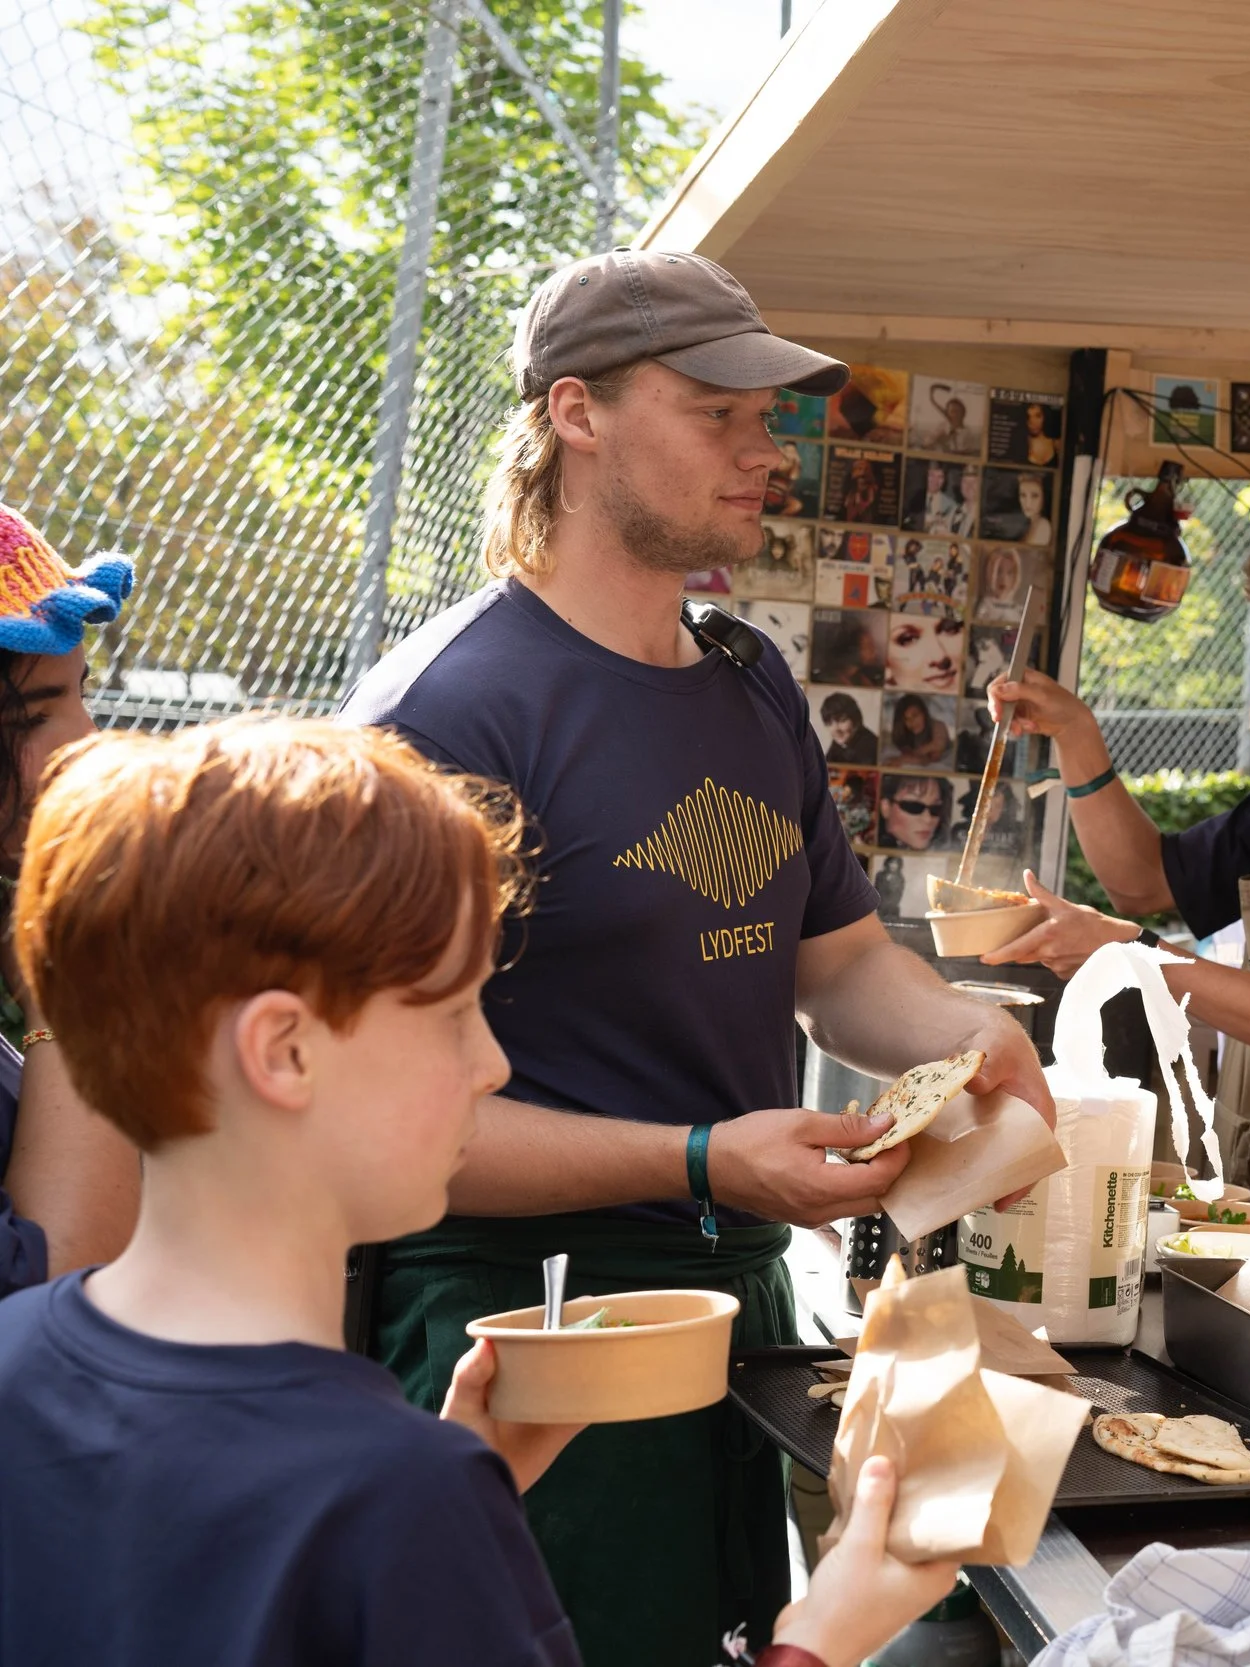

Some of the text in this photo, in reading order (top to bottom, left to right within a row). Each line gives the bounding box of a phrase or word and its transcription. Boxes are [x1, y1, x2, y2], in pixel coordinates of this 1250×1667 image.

[699, 921, 775, 962] LYDFEST
[1103, 1171, 1118, 1248] Kitchenette
[969, 1231, 992, 1250] 400
